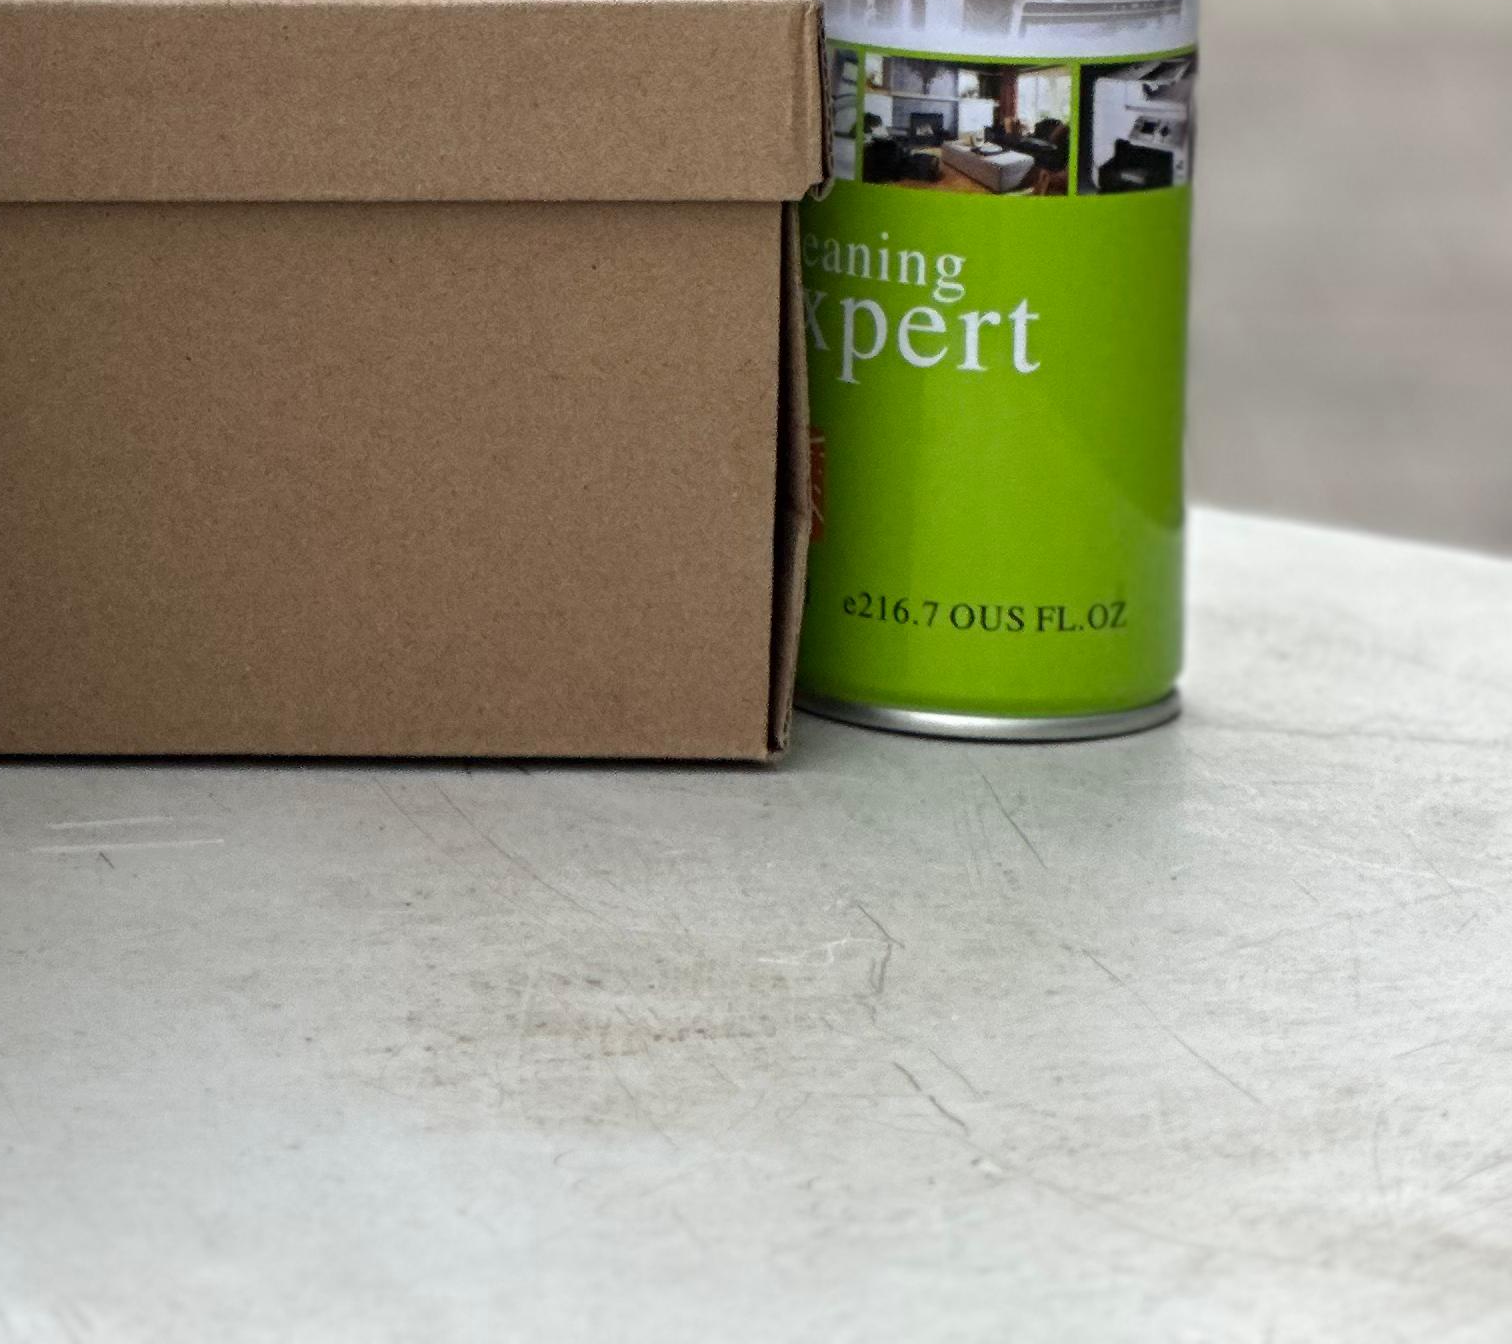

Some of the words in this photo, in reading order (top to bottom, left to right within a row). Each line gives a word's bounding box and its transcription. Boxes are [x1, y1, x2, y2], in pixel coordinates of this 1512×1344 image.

[802, 230, 966, 304] eaning
[803, 287, 1041, 385] xpert
[949, 602, 1025, 633] OUS
